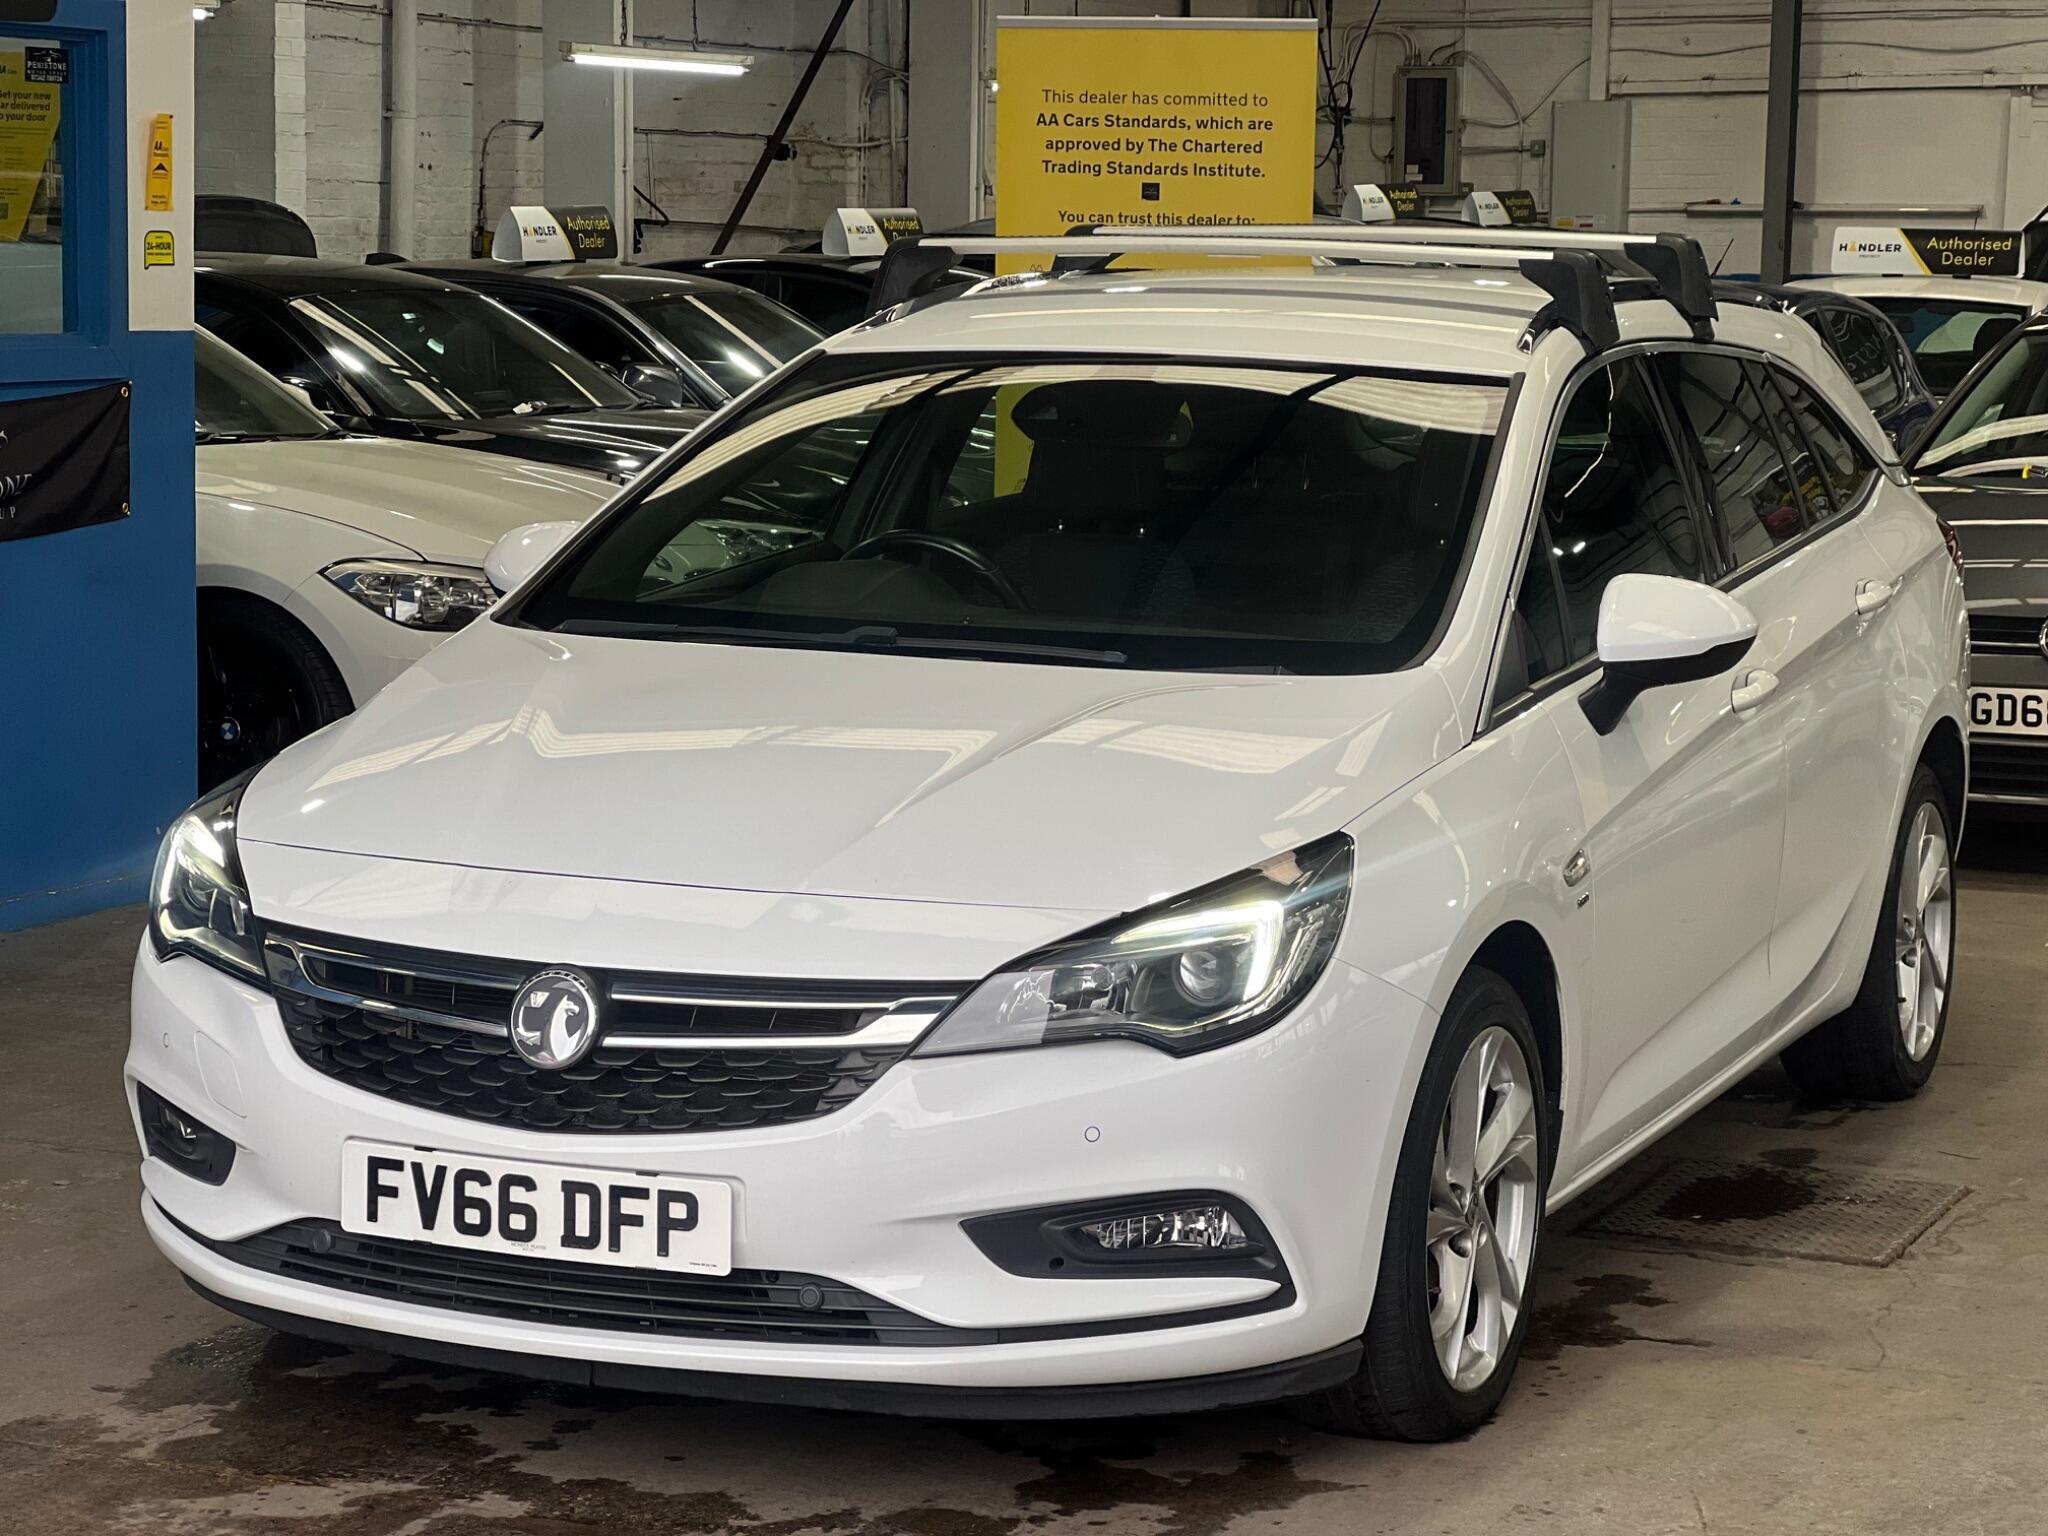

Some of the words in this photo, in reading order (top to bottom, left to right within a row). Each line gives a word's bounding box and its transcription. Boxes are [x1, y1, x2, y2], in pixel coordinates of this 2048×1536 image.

[13, 91, 32, 101] your
[33, 92, 52, 101] new
[1042, 89, 1074, 103] This
[1079, 90, 1128, 104] dealer
[1132, 91, 1158, 105] has
[1163, 92, 1248, 107] committed
[1253, 93, 1268, 107] to
[10, 101, 51, 111] delivered
[6, 113, 25, 122] your
[26, 112, 47, 121] door
[1036, 113, 1059, 126] AA
[1063, 113, 1099, 127] Cars
[1104, 114, 1191, 131] Standards,
[1196, 116, 1243, 130] which
[1248, 119, 1273, 130] are
[1045, 138, 1121, 153] approved
[1126, 138, 1145, 155] by
[1148, 138, 1178, 152] The
[1182, 139, 1263, 154] Chartered
[1042, 160, 1102, 177] Trading
[1106, 161, 1188, 176] Standards
[1193, 162, 1265, 178] Institute.
[567, 216, 611, 231] Authorised
[883, 216, 920, 231] Authorised
[1058, 210, 1084, 223] You
[1088, 213, 1114, 224] can
[1118, 212, 1152, 225] trust
[1157, 212, 1183, 225] this
[1187, 213, 1232, 226] dealer
[1236, 215, 1255, 225] to:
[578, 233, 606, 248] Dealer
[1927, 236, 2012, 251] Authorised
[1941, 251, 1995, 267] Dealer
[1971, 692, 2048, 728] GD6
[366, 1155, 538, 1243] FV66
[560, 1179, 699, 1258] DFP
